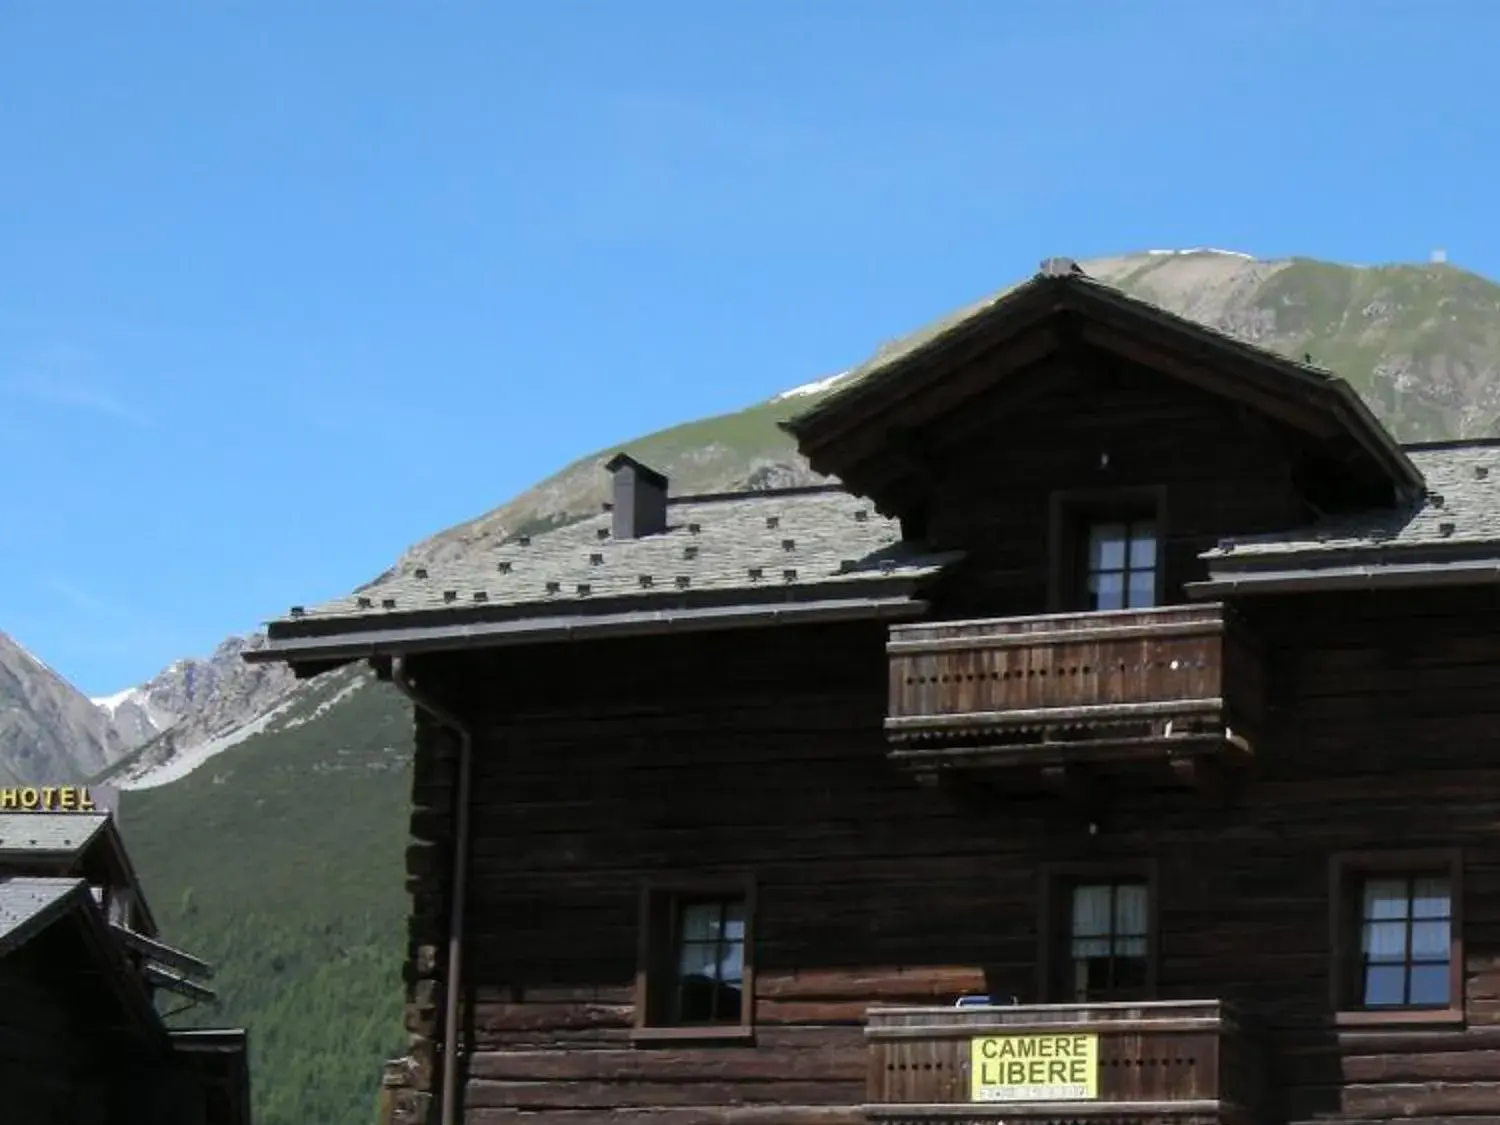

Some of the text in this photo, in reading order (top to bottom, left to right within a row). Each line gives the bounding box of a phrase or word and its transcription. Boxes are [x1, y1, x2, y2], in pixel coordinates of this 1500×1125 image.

[1, 786, 95, 808] HOTEL
[981, 1035, 1088, 1059] CAMERE
[981, 1059, 1088, 1085] LIBERE
